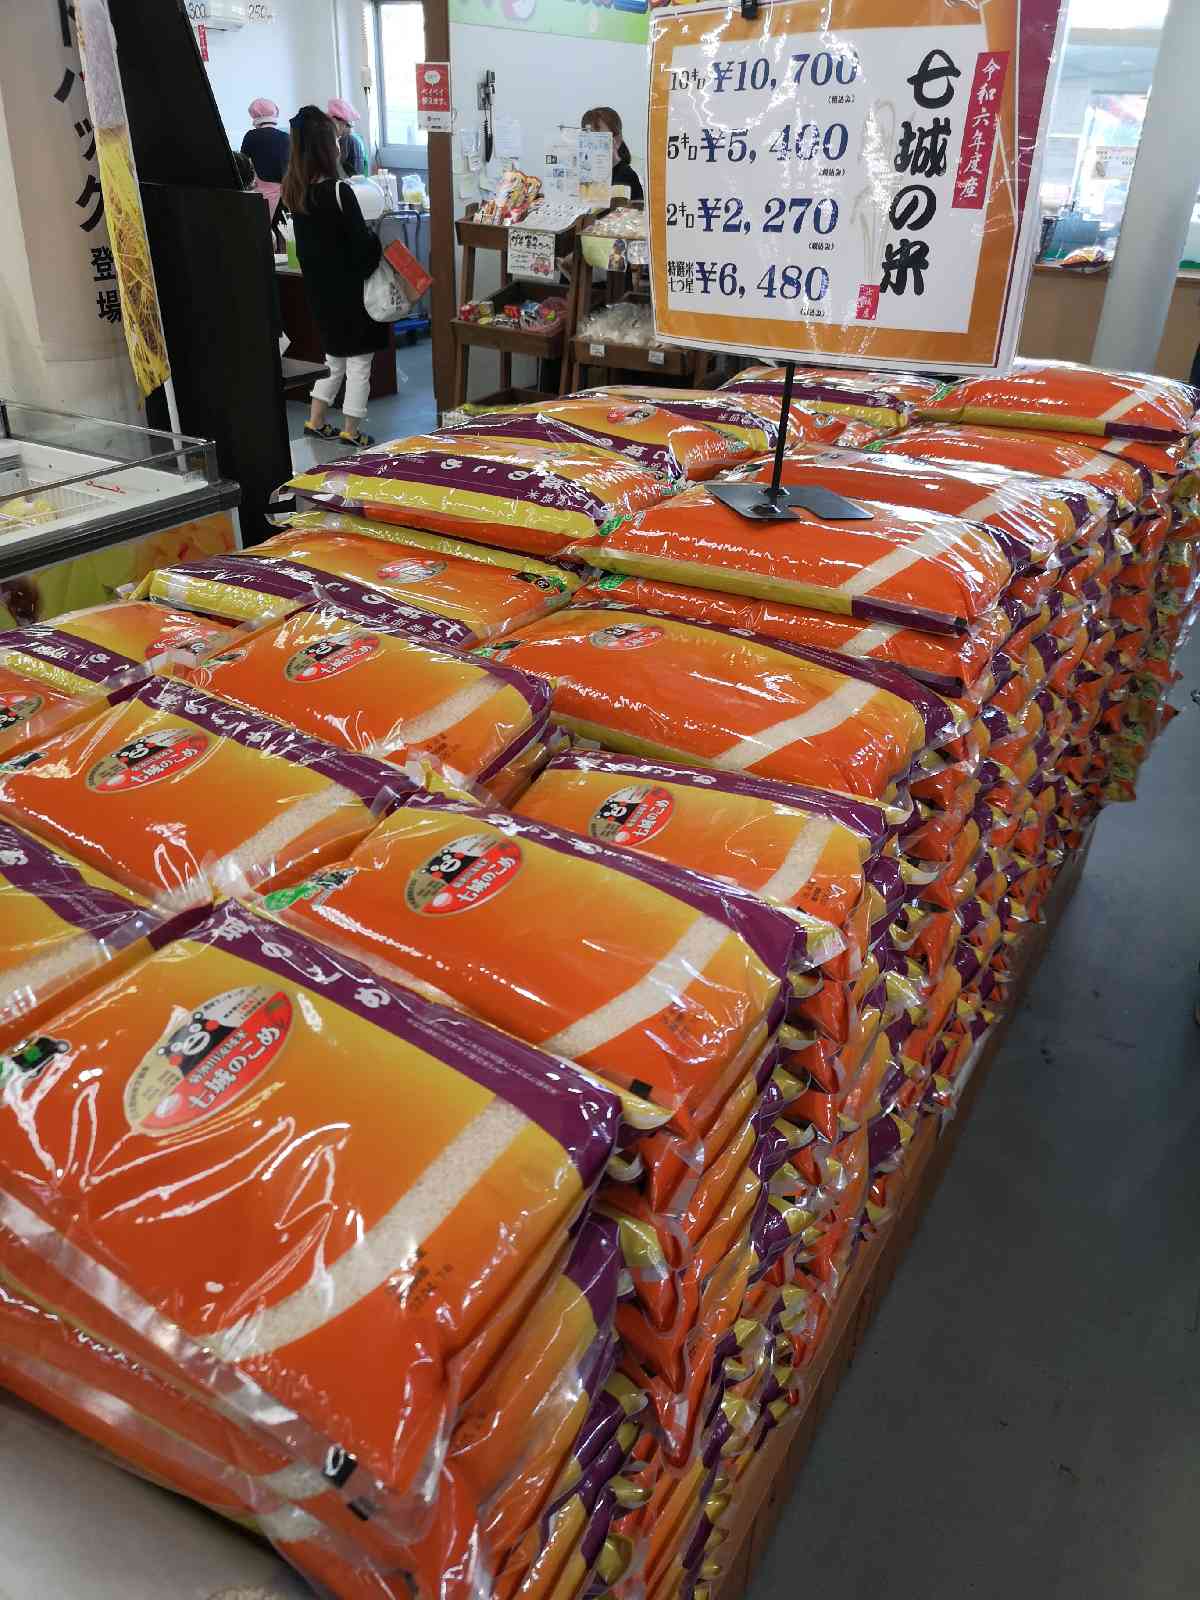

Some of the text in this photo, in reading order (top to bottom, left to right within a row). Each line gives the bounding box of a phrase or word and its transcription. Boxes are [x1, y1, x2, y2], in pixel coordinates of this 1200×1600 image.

[667, 122, 849, 164] 5キロ ¥5,400
[957, 57, 1001, 200] 令和六年度産
[879, 48, 962, 297] 七城の米
[666, 197, 839, 236] 2キロ ¥2,270
[695, 261, 830, 301] ¥6,480
[457, 856, 517, 903] 七城のこめ
[188, 1026, 281, 1109] 七城のこめ
